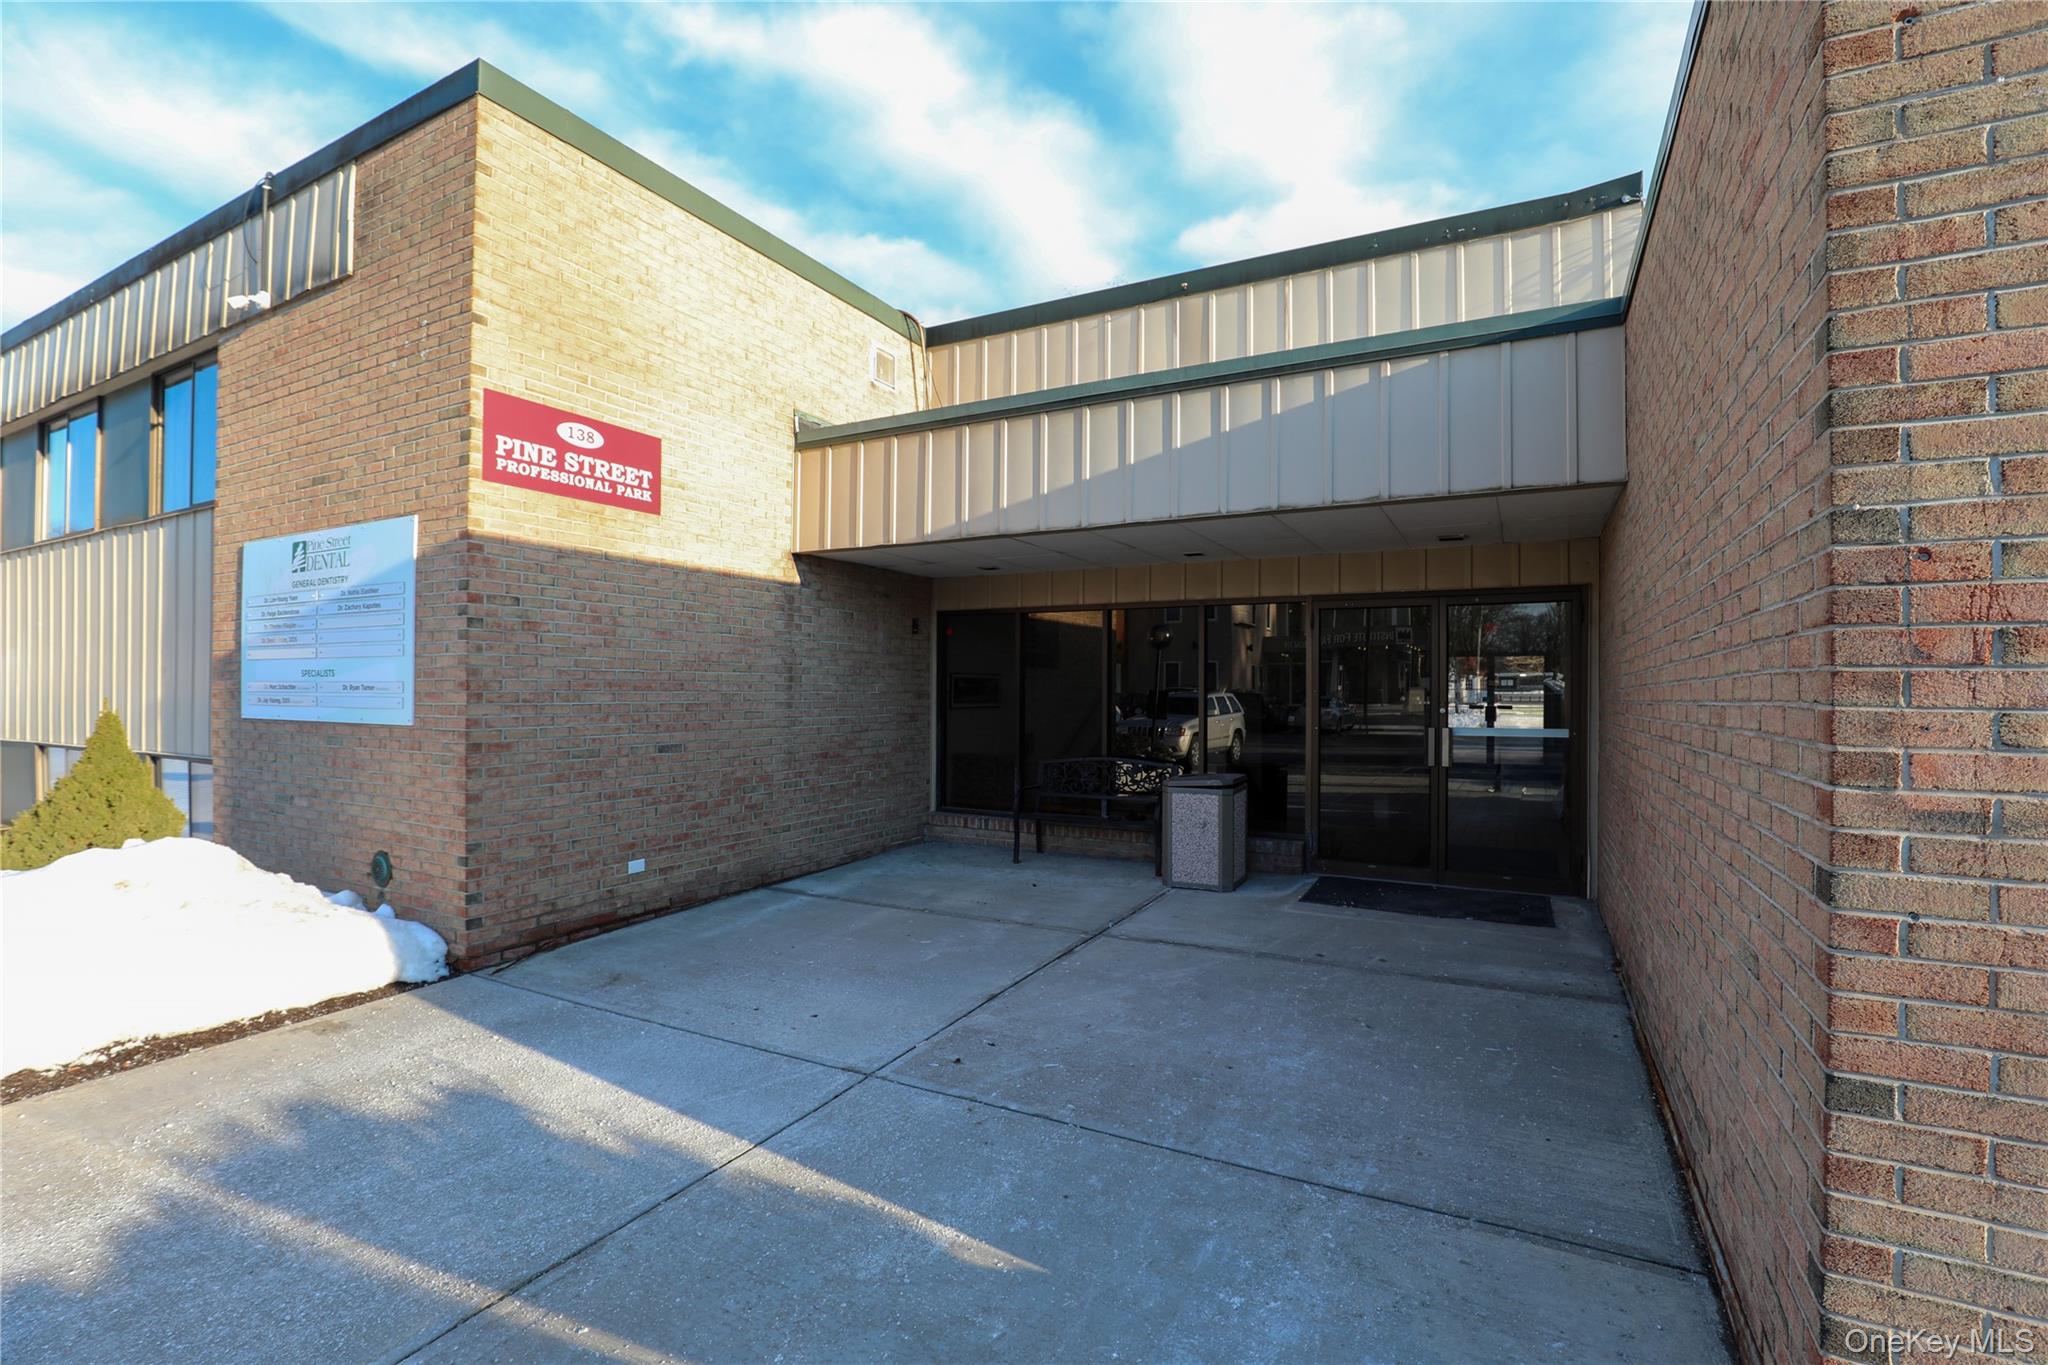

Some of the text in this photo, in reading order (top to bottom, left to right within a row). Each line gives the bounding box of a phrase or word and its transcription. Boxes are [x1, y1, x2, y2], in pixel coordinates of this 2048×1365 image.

[568, 426, 596, 444] 138
[495, 434, 653, 489] PINE STREET
[495, 457, 653, 502] PROFESSIONAL PARK
[307, 536, 351, 552] Pine Street
[306, 551, 351, 571] DENTAL
[291, 575, 349, 589] GENERAL DENTISTRY
[300, 668, 335, 678] SPECIALISTS
